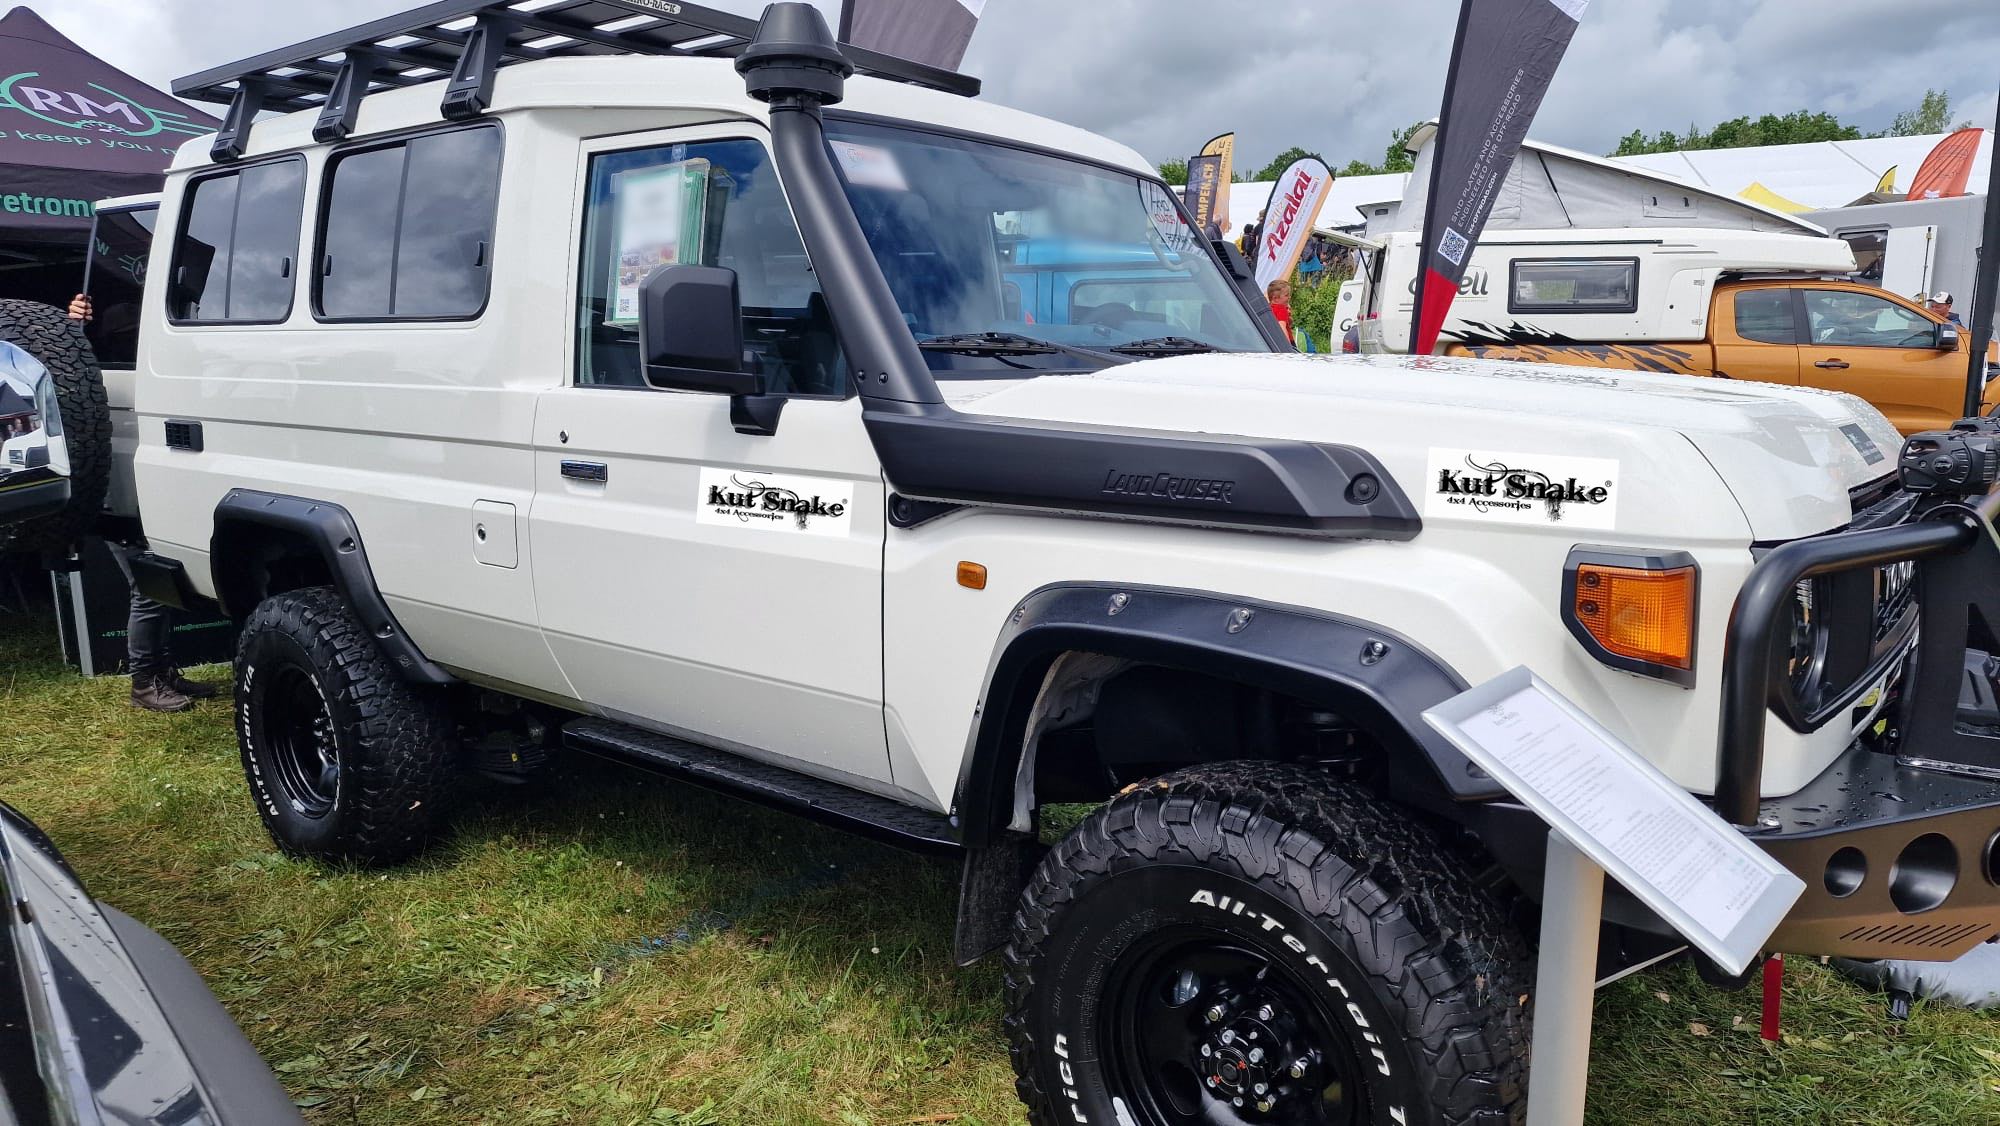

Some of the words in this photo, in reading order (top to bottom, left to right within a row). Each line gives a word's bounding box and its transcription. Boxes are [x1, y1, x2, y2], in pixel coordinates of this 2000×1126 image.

[19, 86, 145, 126] RM
[16, 129, 92, 147] keep
[100, 139, 153, 153] you
[1451, 199, 1464, 223] SKID
[1462, 161, 1481, 197] PLATES
[1479, 139, 1491, 161] AND
[1490, 68, 1524, 138] ACCESSORIES
[1457, 165, 1488, 228] ENGINEERED
[1486, 143, 1499, 164] FOR
[0, 192, 97, 217] etrom
[1436, 468, 1504, 496] Kut
[706, 483, 762, 508] Kut
[1446, 496, 1466, 505] 4x4
[1468, 497, 1532, 513] Accessories
[714, 507, 731, 515] 4x4
[732, 508, 785, 522] Accessories
[1189, 889, 1391, 1077] All-Terrain
